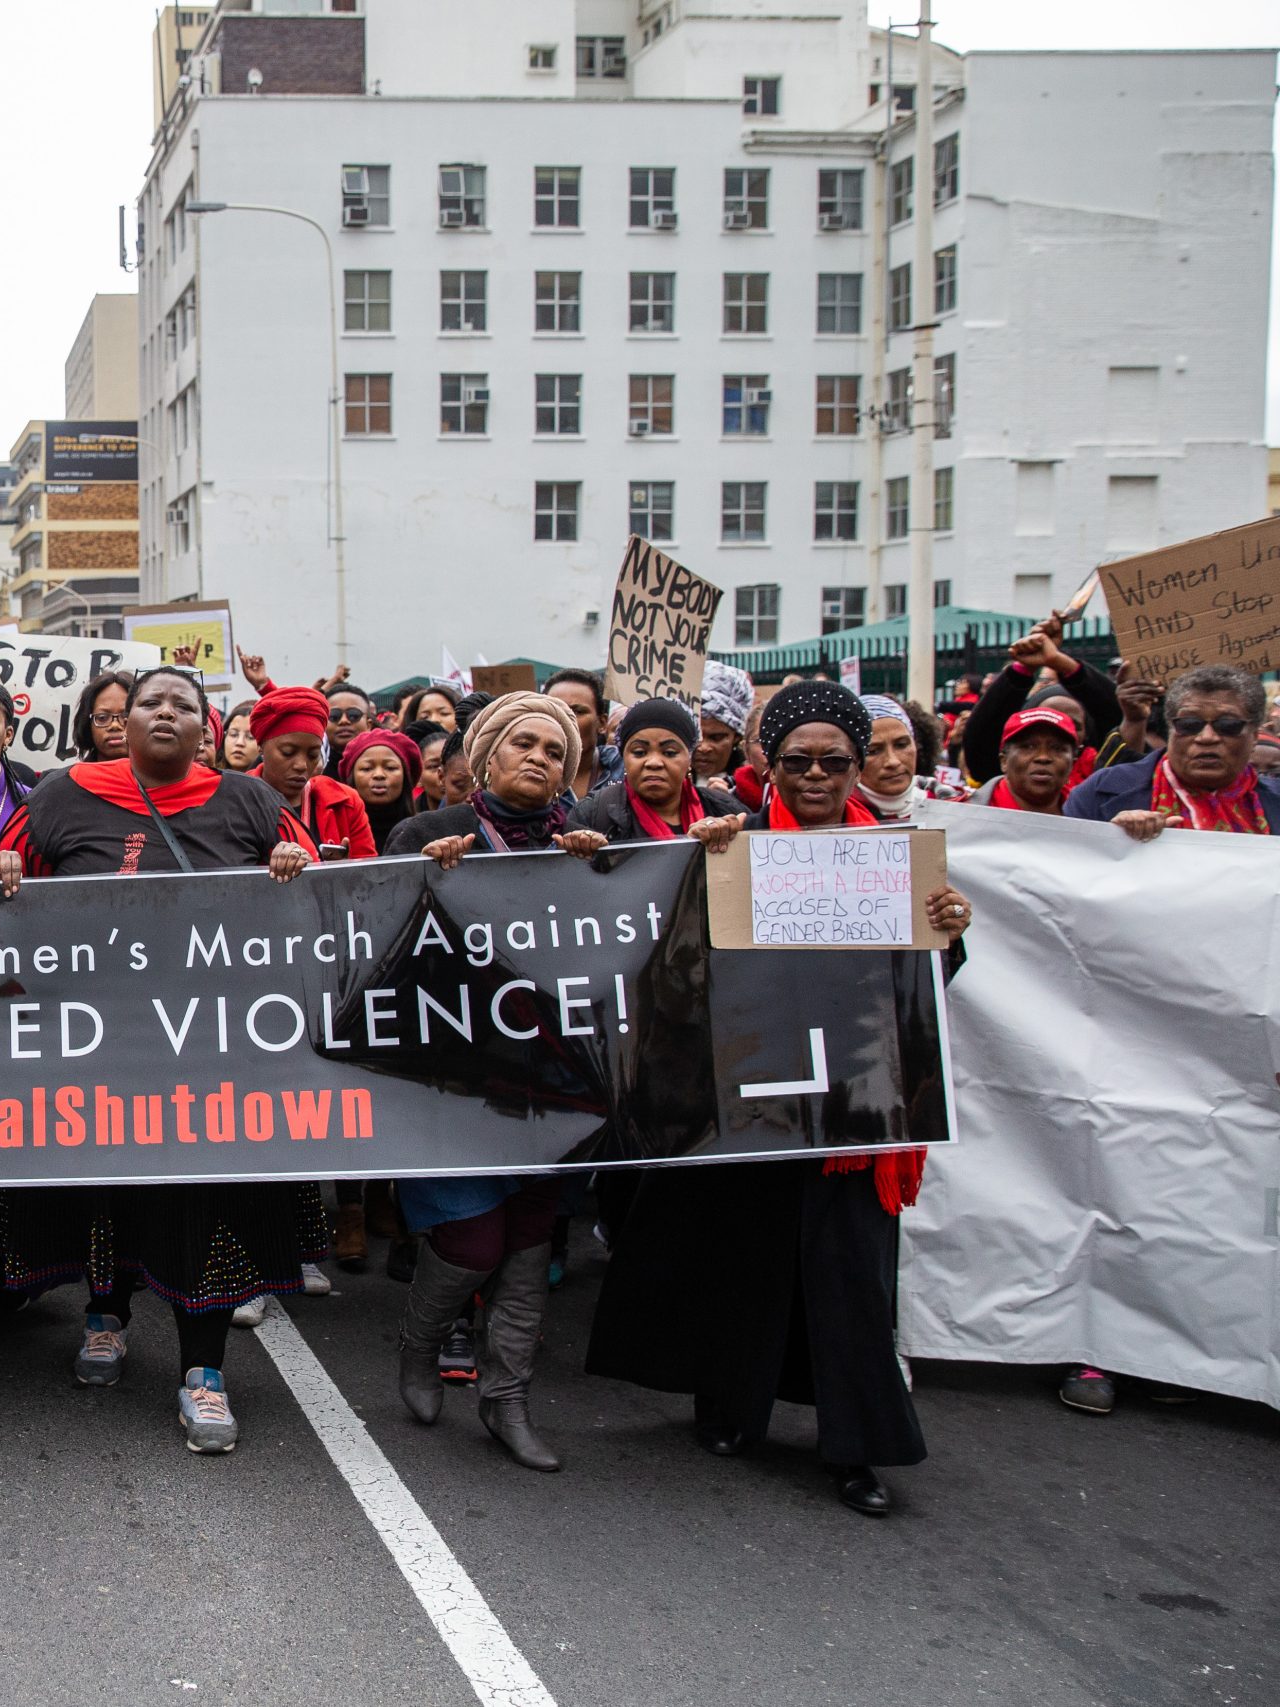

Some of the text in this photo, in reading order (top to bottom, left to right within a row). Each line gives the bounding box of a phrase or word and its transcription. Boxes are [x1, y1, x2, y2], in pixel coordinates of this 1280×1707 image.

[666, 565, 725, 624] BODY
[1108, 563, 1218, 606] Women
[611, 589, 709, 655] NOT YOUR
[751, 837, 913, 867] YOU ARE NOT
[751, 866, 912, 895] WORTH A LEADER
[754, 897, 890, 920] ACCUSED OF
[185, 909, 375, 969] March
[412, 902, 663, 968] Against
[755, 917, 903, 944] GENDER BASED V.
[151, 973, 630, 1057] VIOLENCE!
